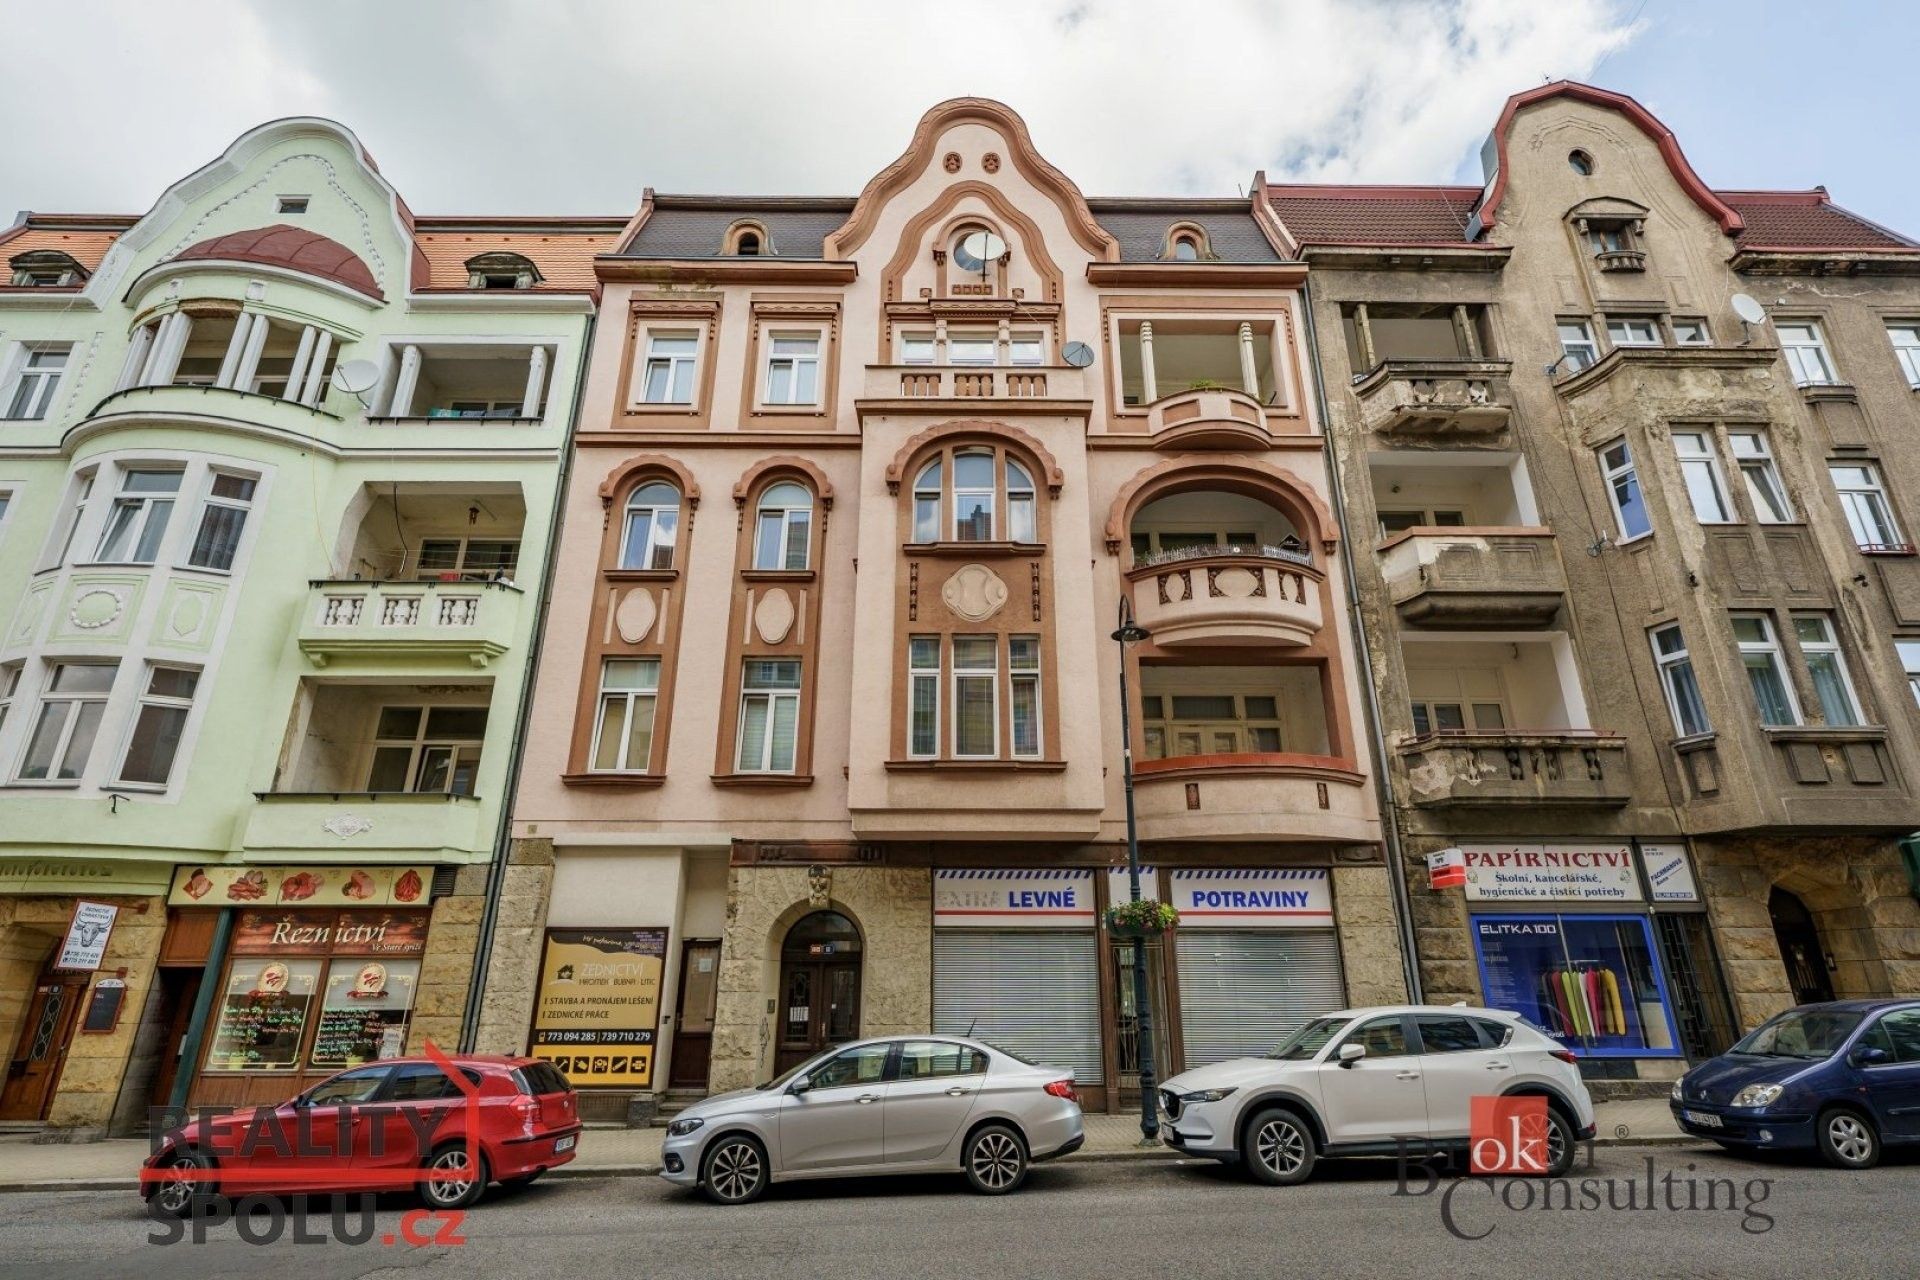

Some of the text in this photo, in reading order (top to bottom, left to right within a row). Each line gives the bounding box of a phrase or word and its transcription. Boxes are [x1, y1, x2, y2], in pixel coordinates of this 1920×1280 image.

[1464, 848, 1631, 867] PAPÍRNICTVÍ
[1008, 887, 1075, 908] LEVNÉ
[1192, 890, 1309, 908] POTRAVINY
[1541, 889, 1547, 897] a
[1479, 925, 1557, 934] ELITKA 100
[548, 1032, 651, 1041] 773 094 285 739 710 279
